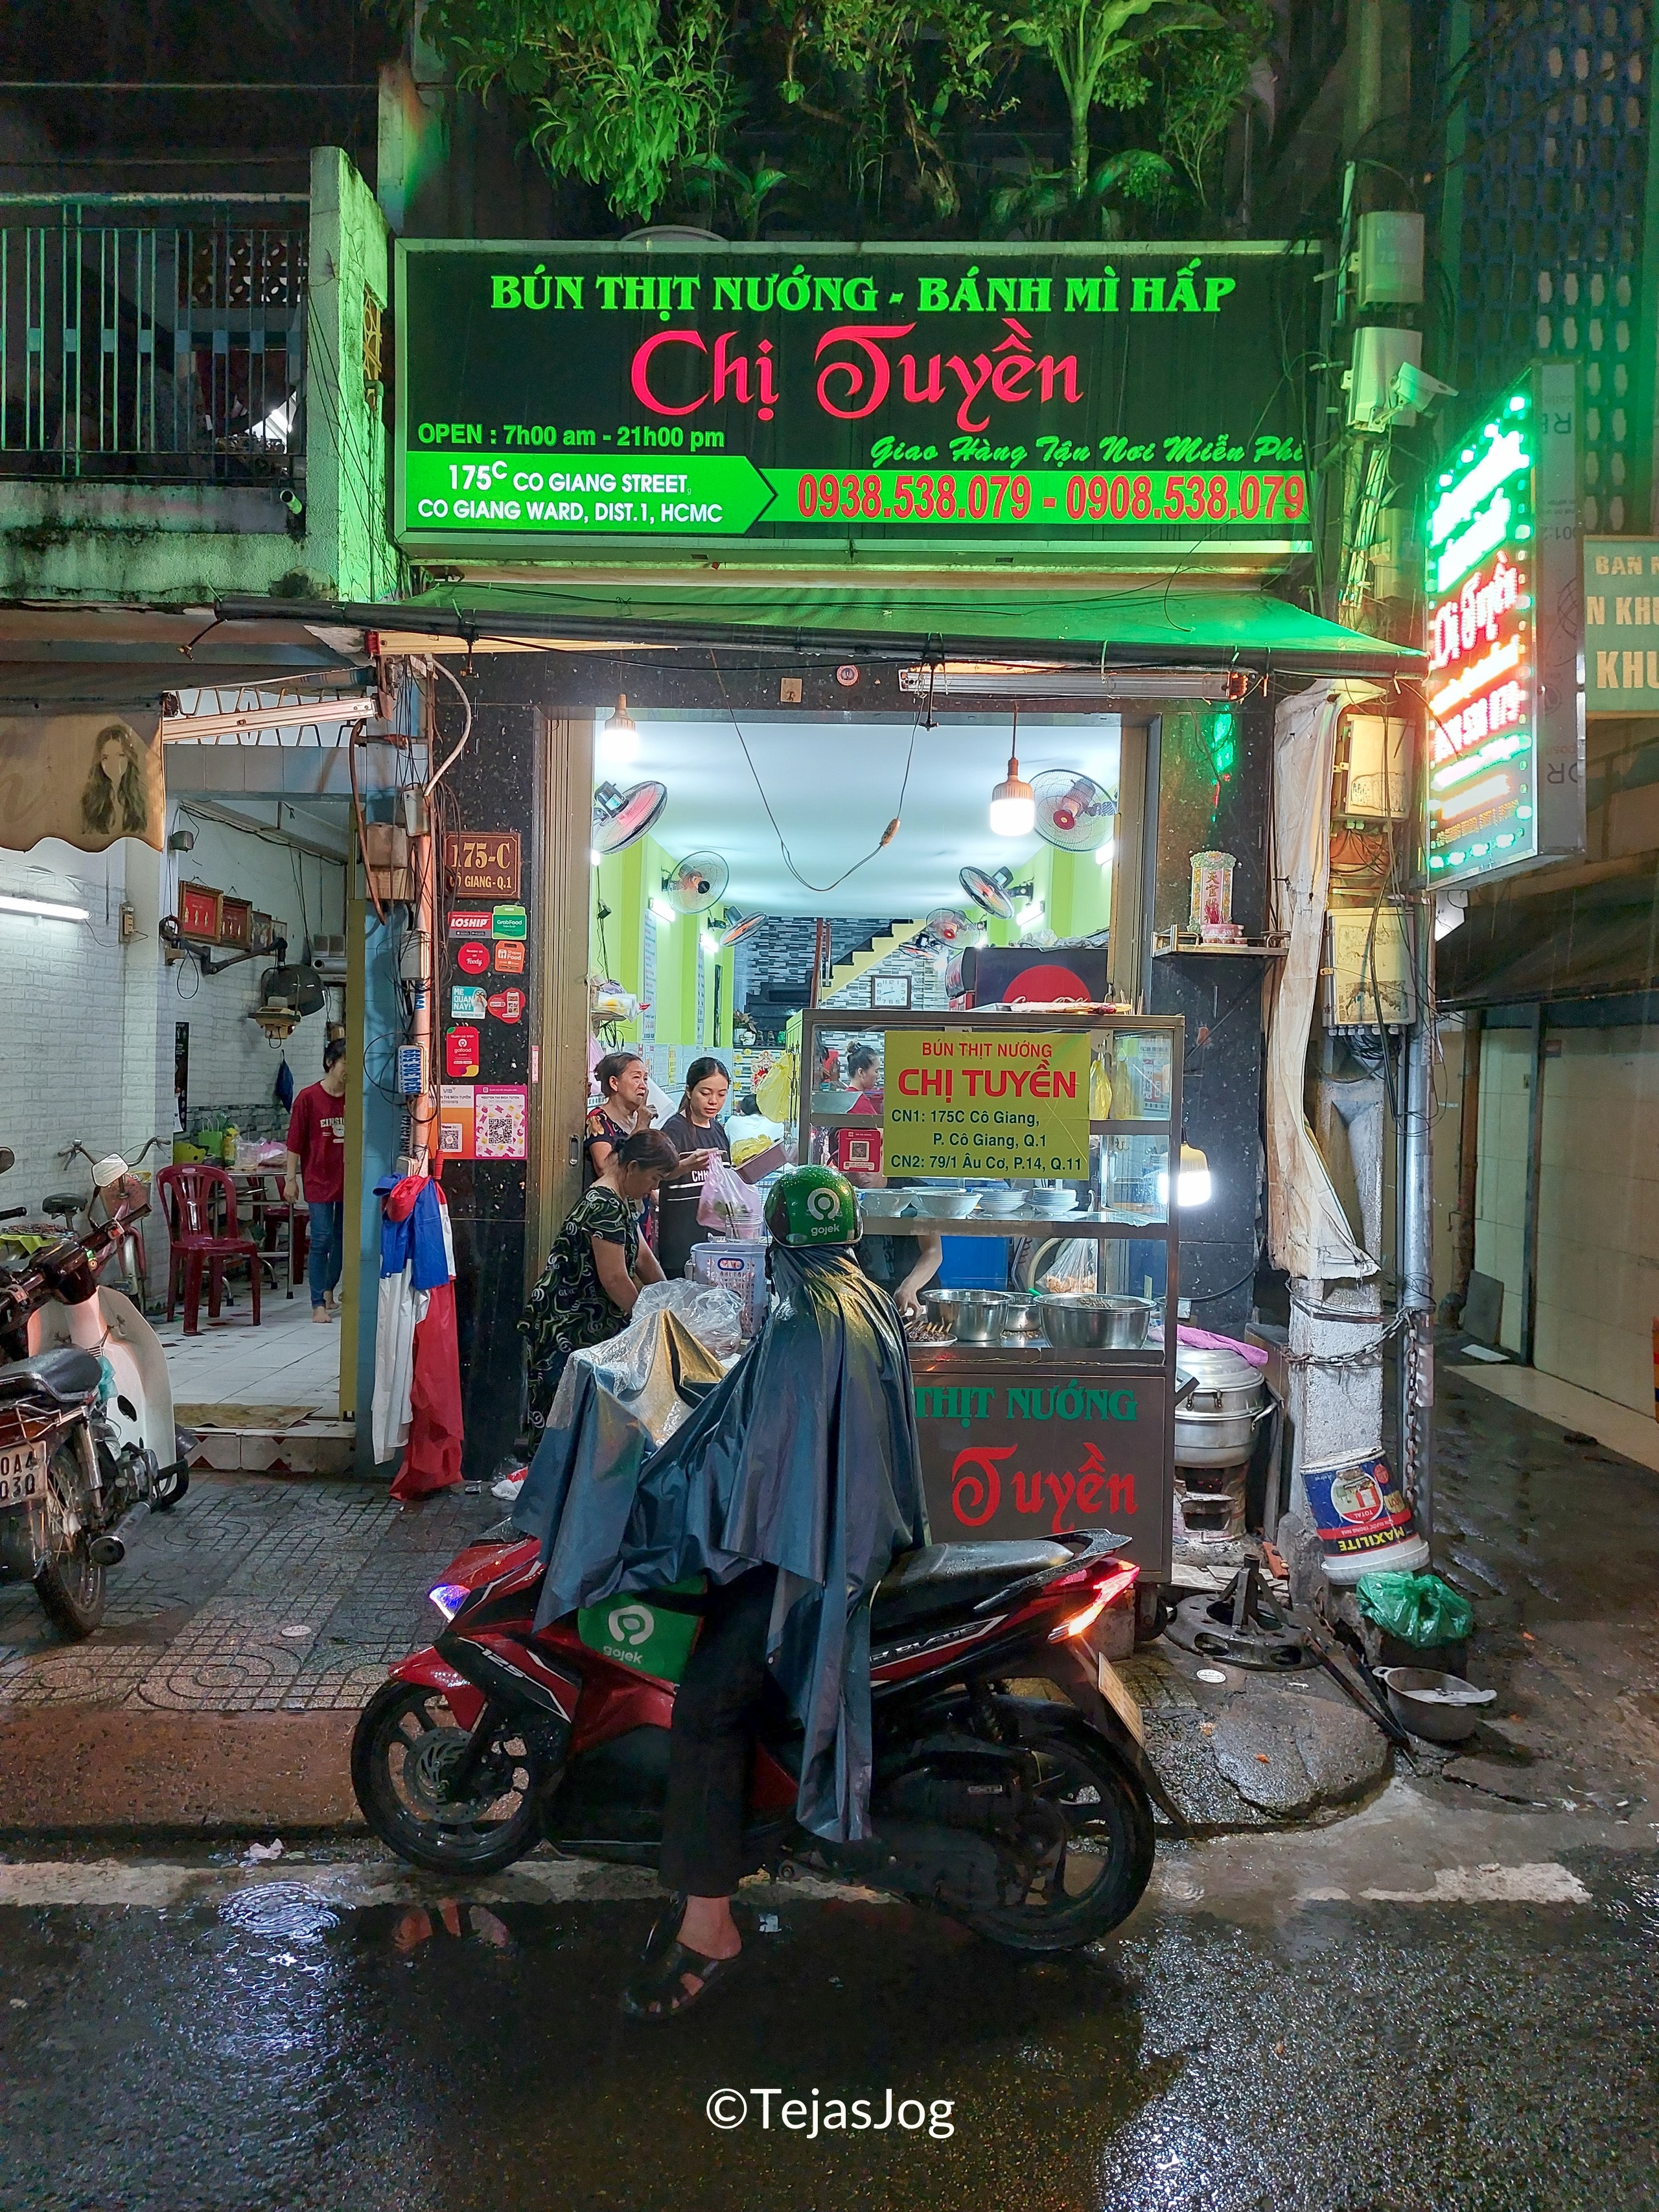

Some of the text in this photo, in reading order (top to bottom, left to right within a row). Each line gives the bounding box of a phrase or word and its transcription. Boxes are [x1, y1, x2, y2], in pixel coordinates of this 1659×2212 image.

[491, 258, 1236, 321] BÚN THỊT NƯỚNG - BÁNH MÌ HẤP
[631, 318, 1084, 432] Chị Tuyền
[418, 423, 483, 445] OPEN
[503, 425, 557, 447] 7h00
[563, 430, 597, 447] am
[616, 425, 684, 447] 21h00
[690, 431, 726, 452] pm
[870, 436, 939, 467] Giao
[949, 436, 1028, 468] Hàng
[1035, 436, 1091, 468] Tận
[1099, 436, 1157, 463] Nơi
[1161, 434, 1245, 463] Miễn
[513, 472, 544, 492] CO
[548, 472, 617, 493] GIANG
[622, 473, 691, 495] STREET,
[798, 472, 1032, 520] 0938.538.079
[1067, 474, 1305, 520] 0908.538.079
[418, 499, 724, 524] CO GIANG WARD, DIST.1, HCMC
[1595, 556, 1643, 576] BAN
[451, 841, 511, 869] 175-C
[450, 918, 492, 927] LOSHIP
[466, 958, 483, 967] Foody
[922, 1039, 1052, 1060] BÚN THỊT NƯỚNG
[898, 1058, 1076, 1103] CHỊ TUYỀN
[891, 1106, 1039, 1127] CN1: 175C Cô Giang,
[933, 1130, 1047, 1150] P. Cô Giang, Q.1
[891, 1152, 1081, 1172] CN2: 79/1 Âu Cơ, P.14, Q.11
[811, 1224, 840, 1237] gojek
[914, 1379, 1137, 1428] THỊT NƯỚNG
[951, 1442, 1139, 1533] Tuyền
[1354, 1509, 1373, 1518] TOTAL
[1338, 1526, 1406, 1552] MAXILITE
[481, 1648, 526, 1678] 125
[603, 1645, 644, 1664] gojek
